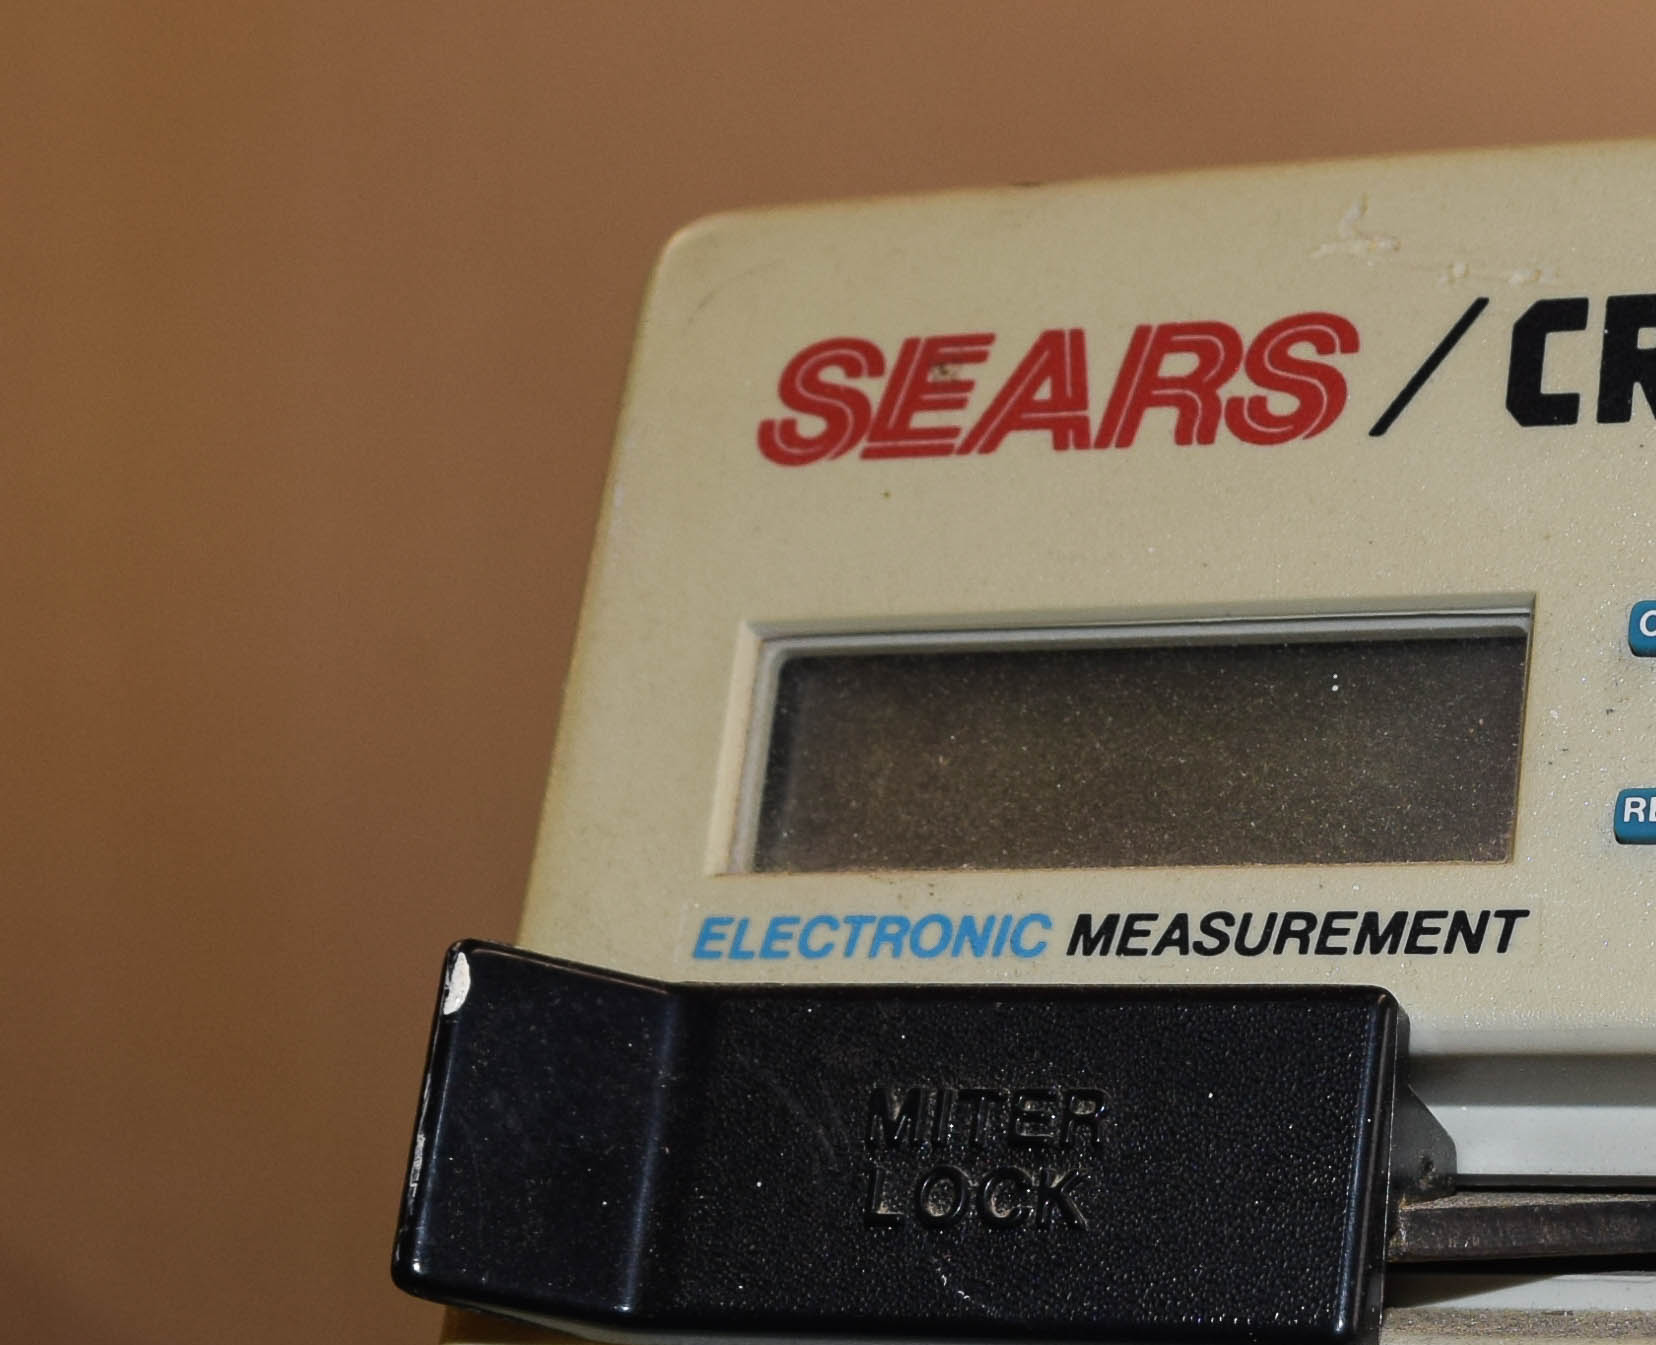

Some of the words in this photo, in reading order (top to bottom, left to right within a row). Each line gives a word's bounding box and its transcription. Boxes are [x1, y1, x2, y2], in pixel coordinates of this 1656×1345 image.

[757, 311, 1360, 467] SEARS
[692, 912, 1053, 961] ELECTRONIC
[1066, 908, 1530, 959] MEASUREMENT
[864, 1085, 1109, 1152] MITER
[862, 1164, 1090, 1232] LOCK
